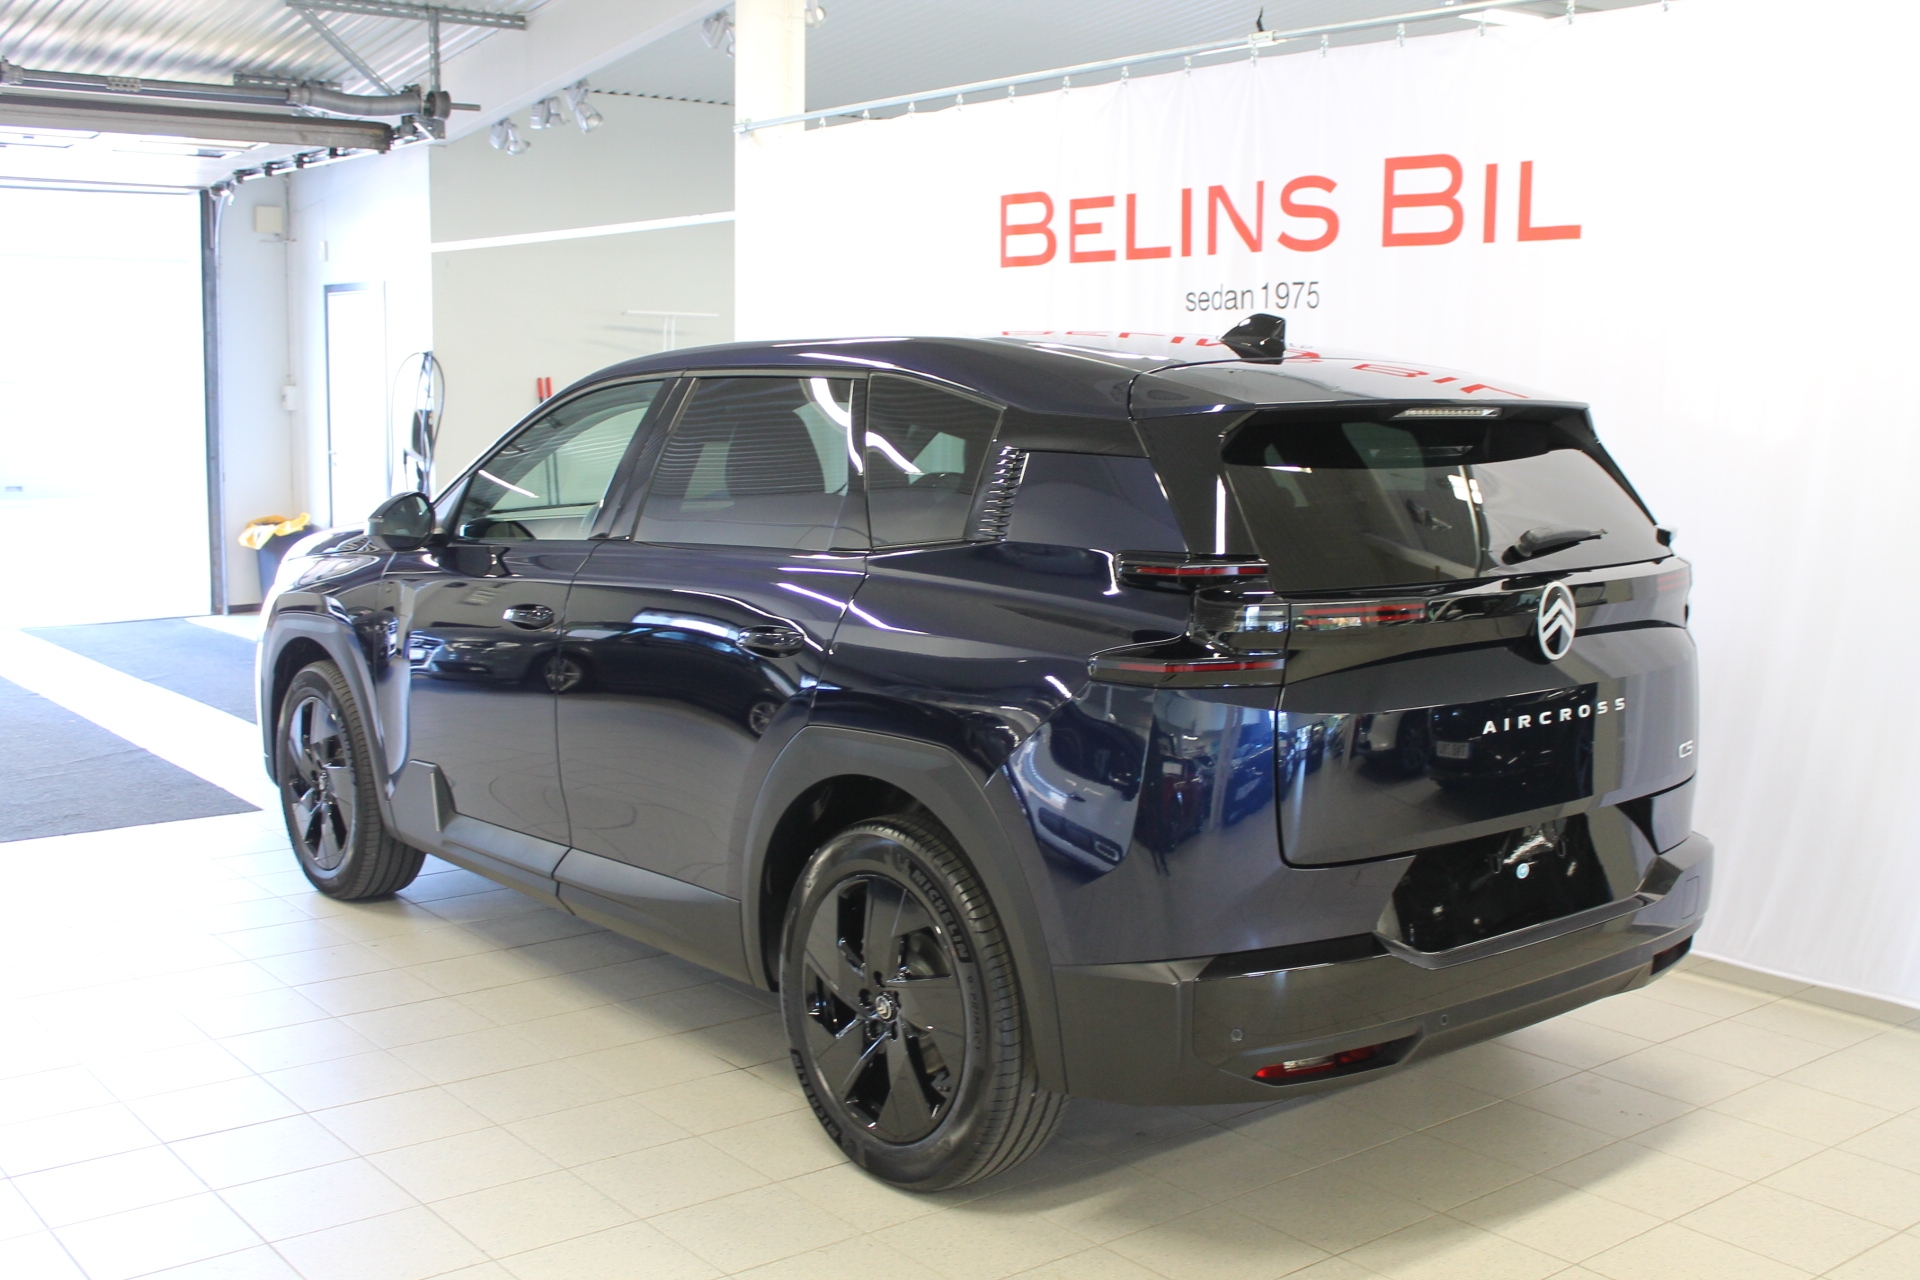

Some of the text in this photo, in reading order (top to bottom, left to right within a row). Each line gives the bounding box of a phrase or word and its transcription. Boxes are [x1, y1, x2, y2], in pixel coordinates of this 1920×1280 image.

[1000, 154, 1582, 268] BELINS BIL
[1186, 281, 1320, 312] sedan 1975
[1482, 697, 1626, 735] AIRCROSS
[910, 869, 971, 960] MICHELIN
